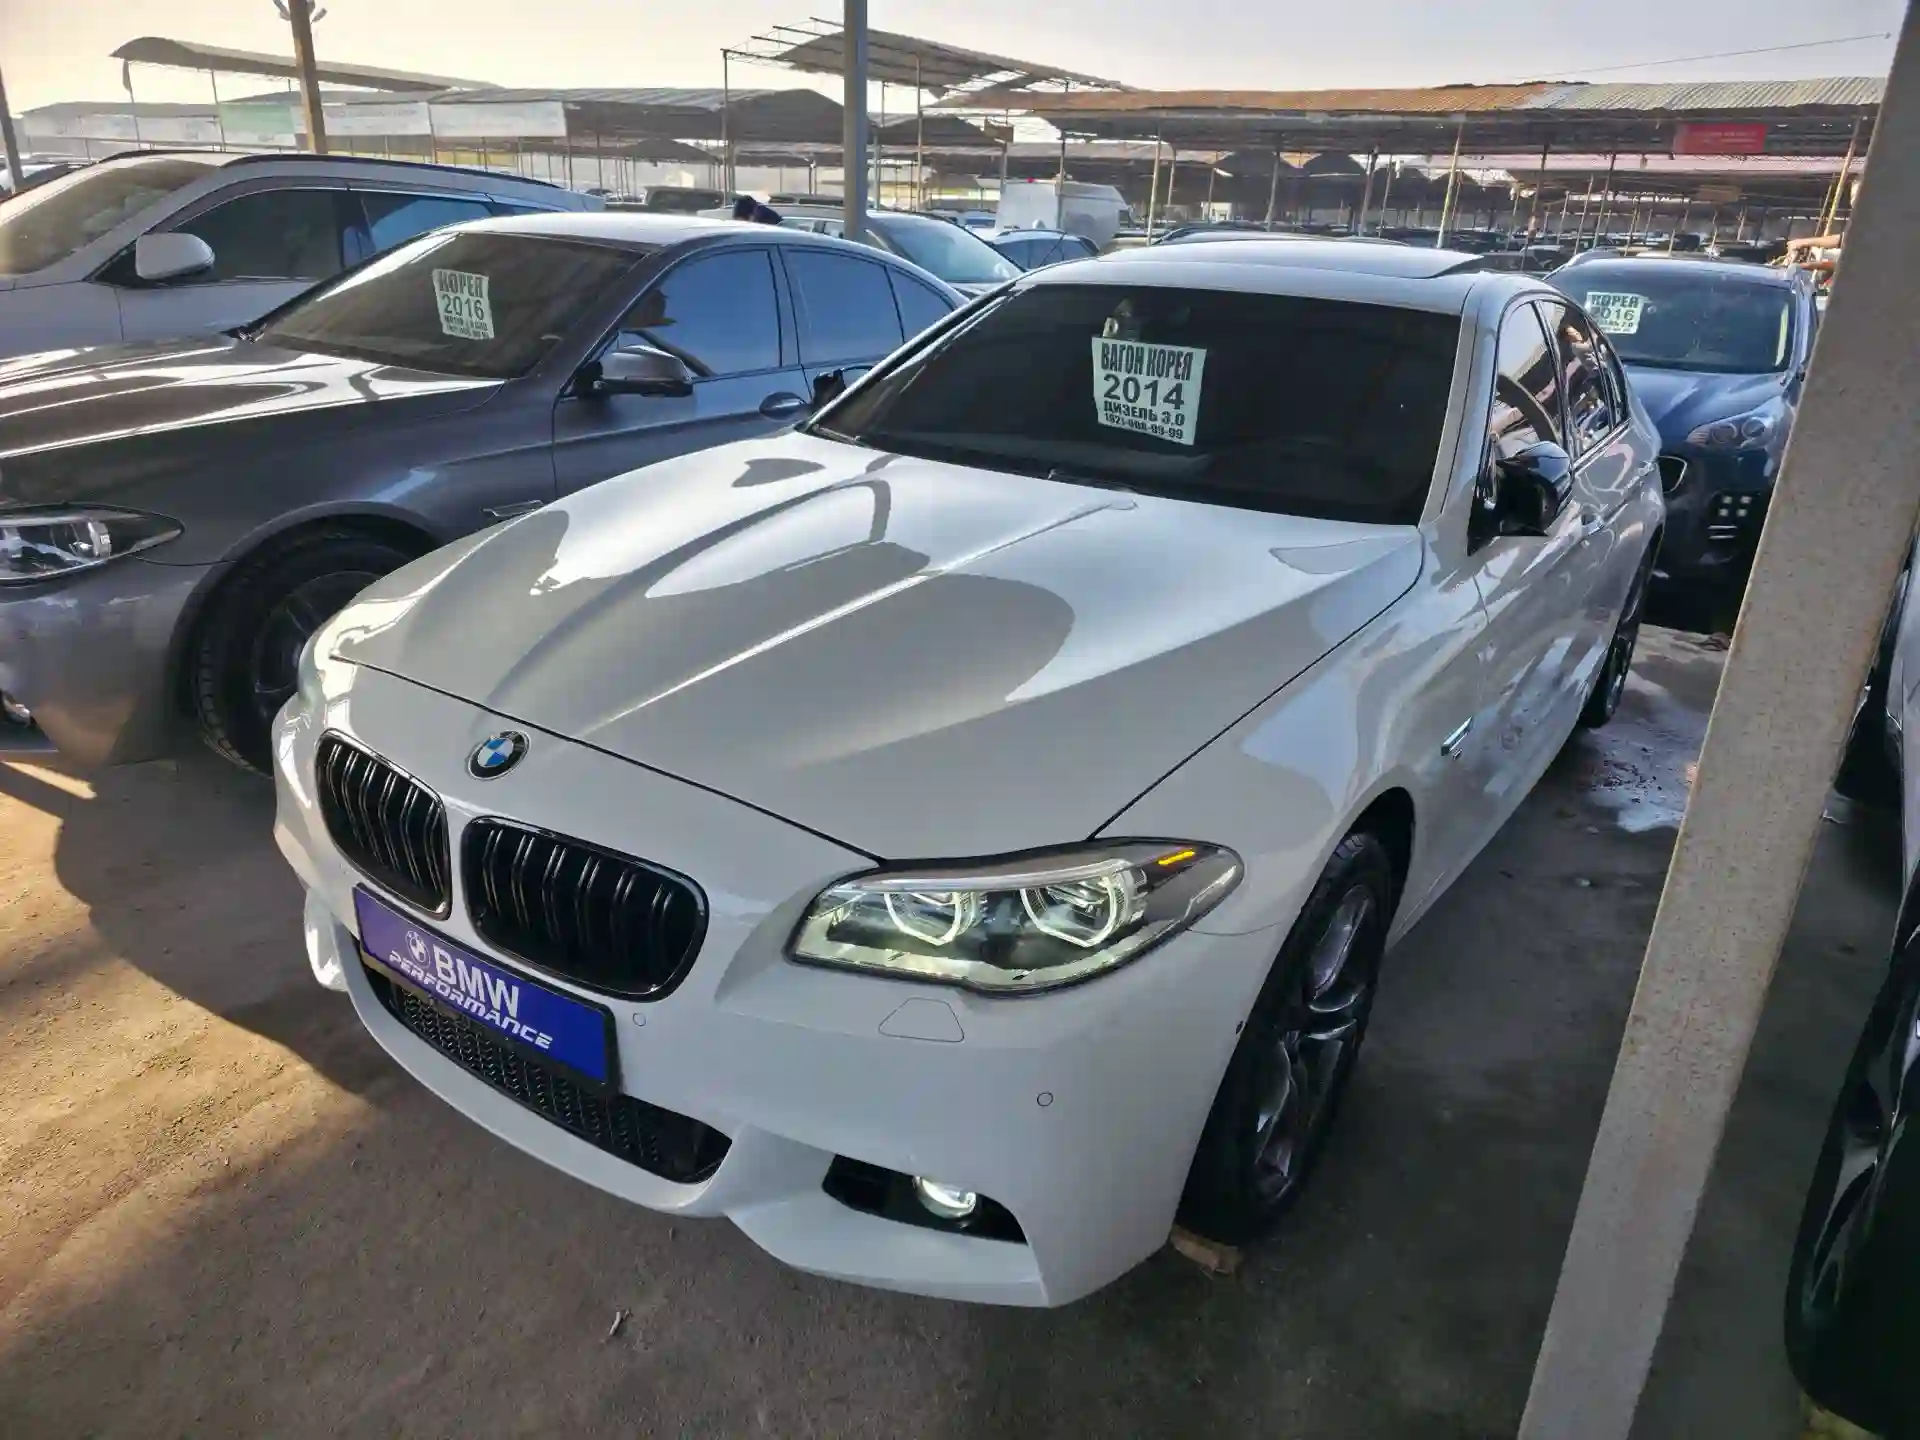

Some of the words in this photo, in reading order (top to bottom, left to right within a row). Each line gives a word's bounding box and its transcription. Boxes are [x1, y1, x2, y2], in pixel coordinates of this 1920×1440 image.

[442, 294, 484, 320] 2016
[1101, 342, 1145, 375] ВАГОН
[1146, 347, 1194, 380] КОРЕЯ
[1103, 373, 1185, 410] 2014
[1103, 400, 1158, 422] ДИЗЕЛЬ
[433, 943, 519, 1018] BMW
[388, 949, 554, 1050] PERFORMANCE
